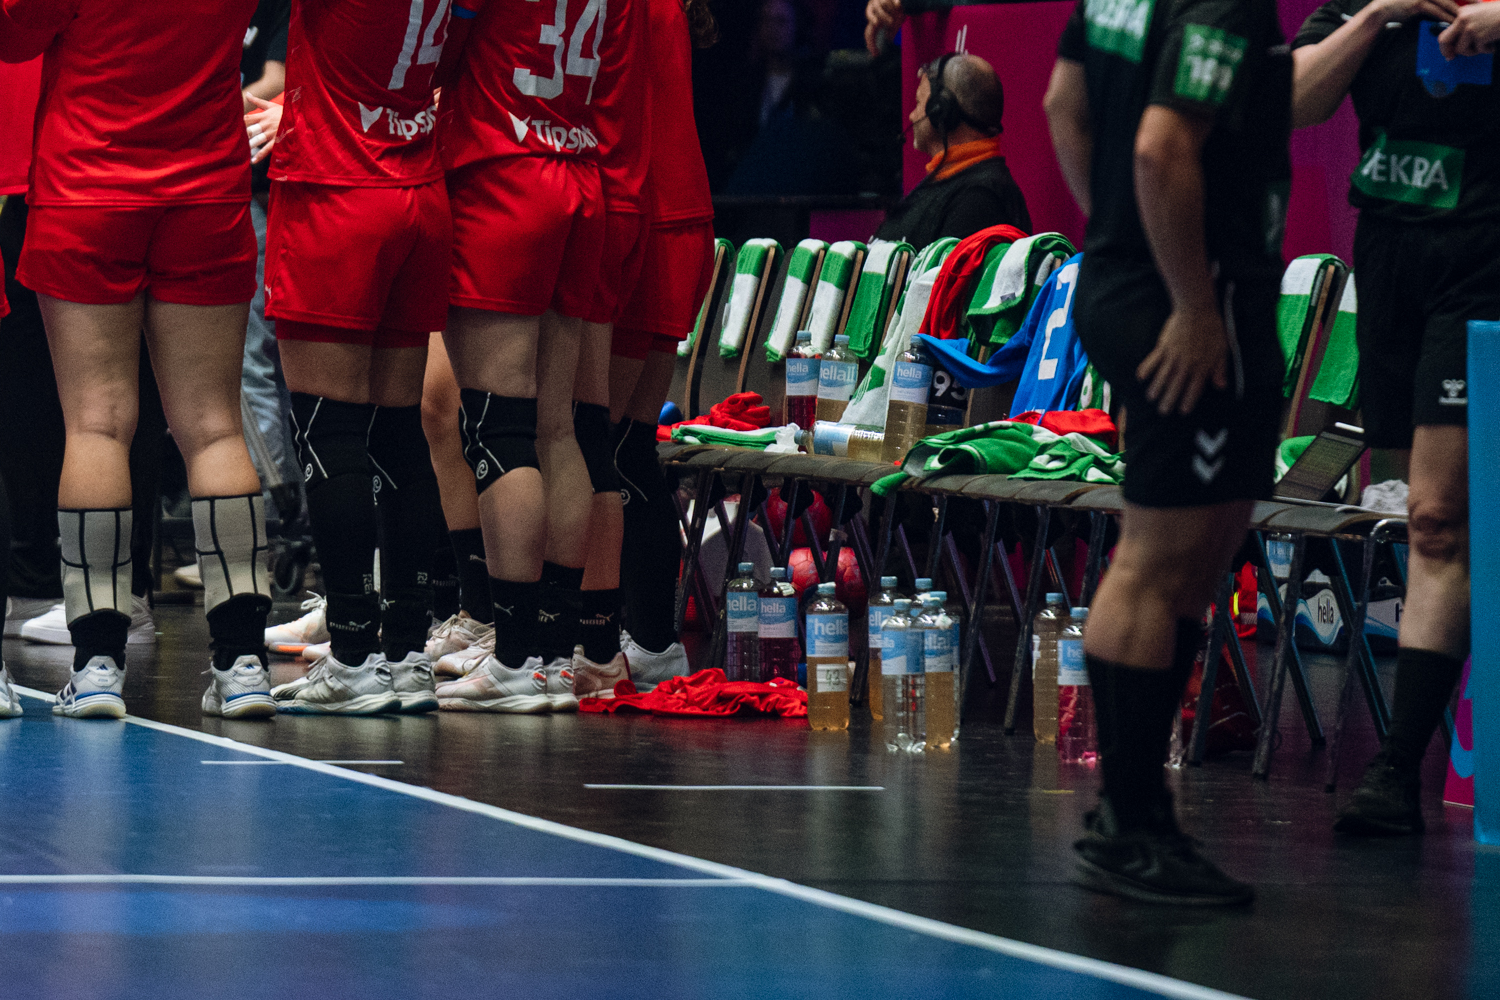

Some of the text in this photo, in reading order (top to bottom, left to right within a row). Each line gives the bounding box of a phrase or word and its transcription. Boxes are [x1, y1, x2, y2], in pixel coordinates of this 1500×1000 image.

[896, 366, 922, 380] hella
[760, 602, 786, 614] hella
[1317, 597, 1335, 624] hella
